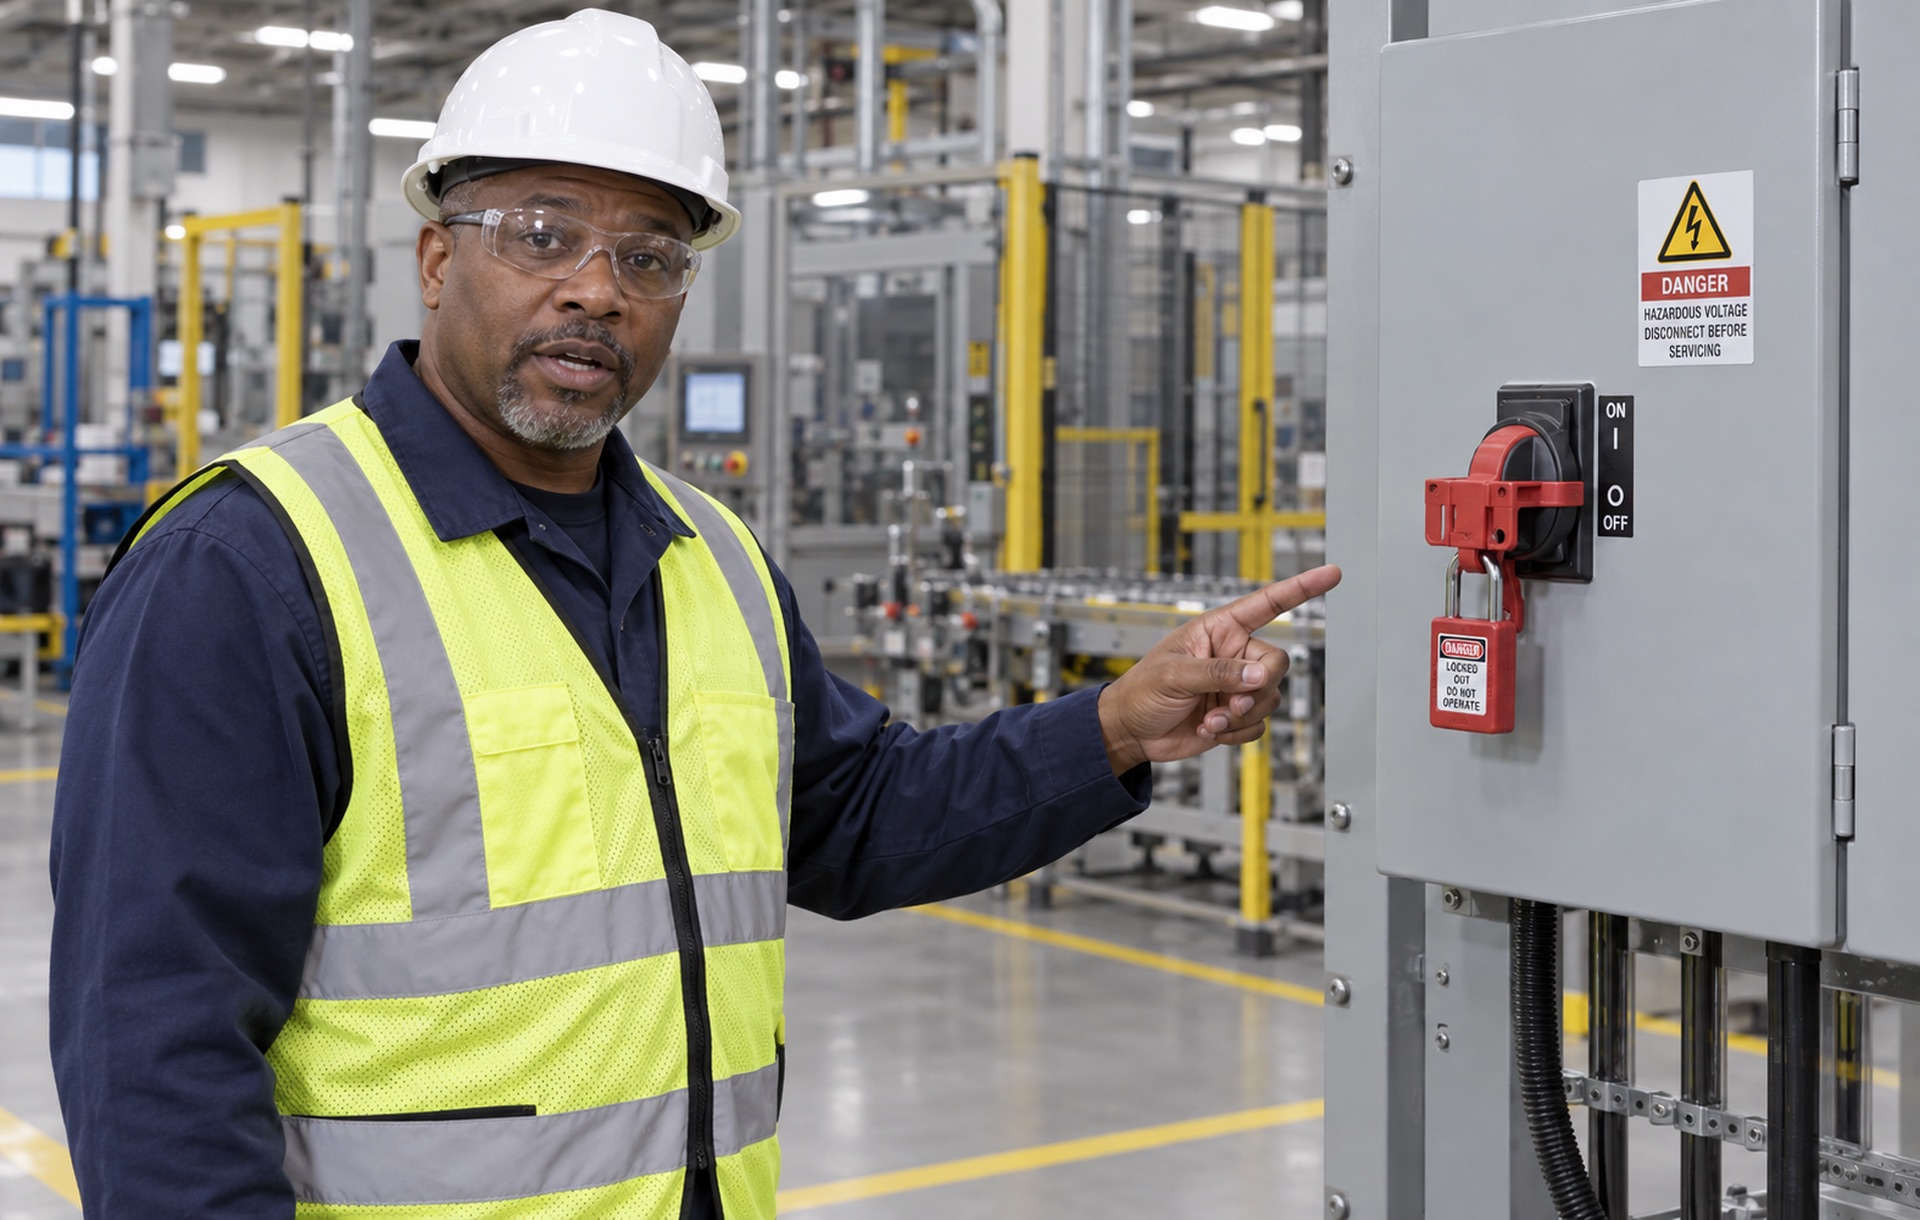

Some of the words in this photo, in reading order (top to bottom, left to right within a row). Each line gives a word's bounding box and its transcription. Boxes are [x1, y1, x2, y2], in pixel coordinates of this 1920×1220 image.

[1662, 274, 1728, 295] DANGER
[1644, 305, 1701, 321] HAZARDOUS
[1704, 303, 1748, 319] VOLTAGE
[1645, 325, 1705, 341] DISCONNECT
[1708, 323, 1747, 339] BEFORE
[1669, 343, 1721, 359] SERVICING
[1606, 402, 1626, 418] ON
[1603, 515, 1628, 531] OFF
[1446, 686, 1458, 696] DO
